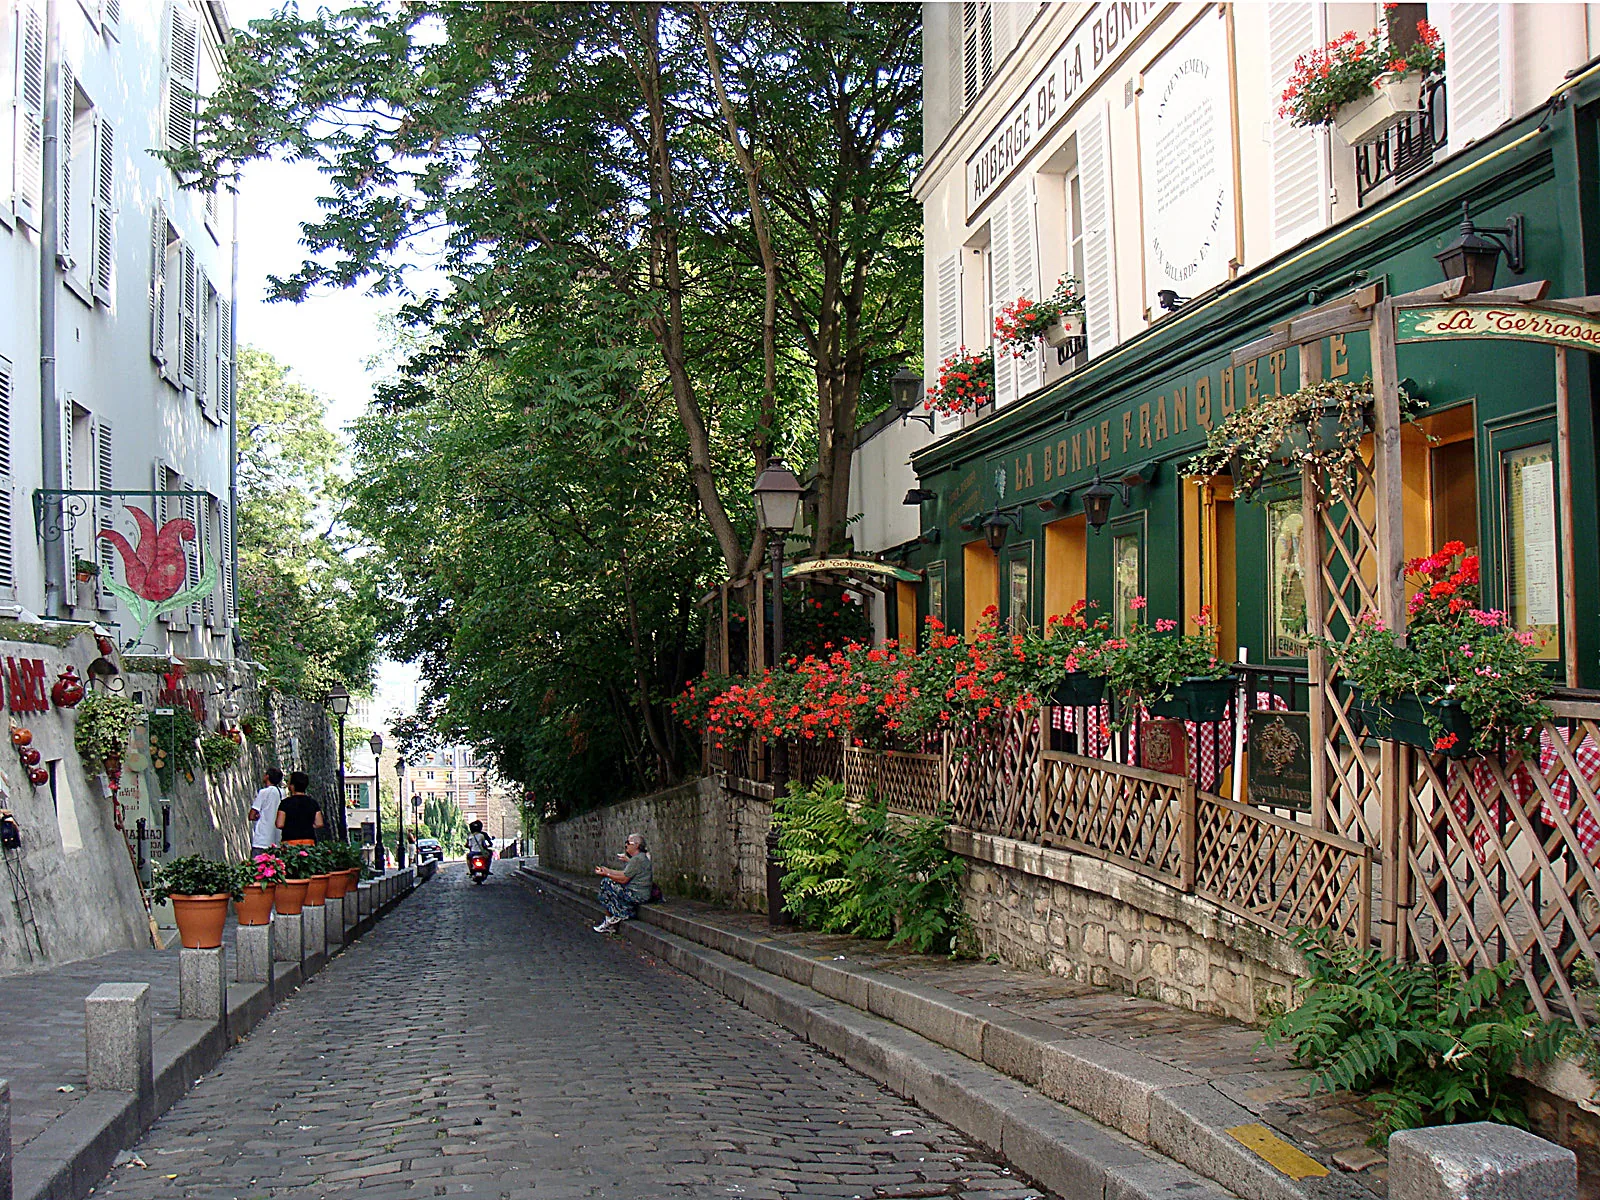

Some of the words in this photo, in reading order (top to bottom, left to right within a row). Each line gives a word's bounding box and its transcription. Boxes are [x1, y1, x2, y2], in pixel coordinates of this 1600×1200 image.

[974, 102, 1031, 202] AUBERGE
[1037, 73, 1057, 132] DE
[1063, 43, 1084, 102] LA
[1156, 58, 1211, 126] ANCIENNEMENT
[1164, 258, 1198, 282] BILLARDS
[1199, 236, 1211, 261] EN
[1210, 188, 1225, 233] BOIS
[1437, 309, 1477, 332] La
[1485, 309, 1600, 344] Terrasse
[1015, 453, 1034, 492] LA
[1043, 419, 1111, 483] BONNE
[1122, 333, 1349, 454] FRANQUETE
[810, 560, 826, 569] La
[829, 560, 875, 569] Terrasse
